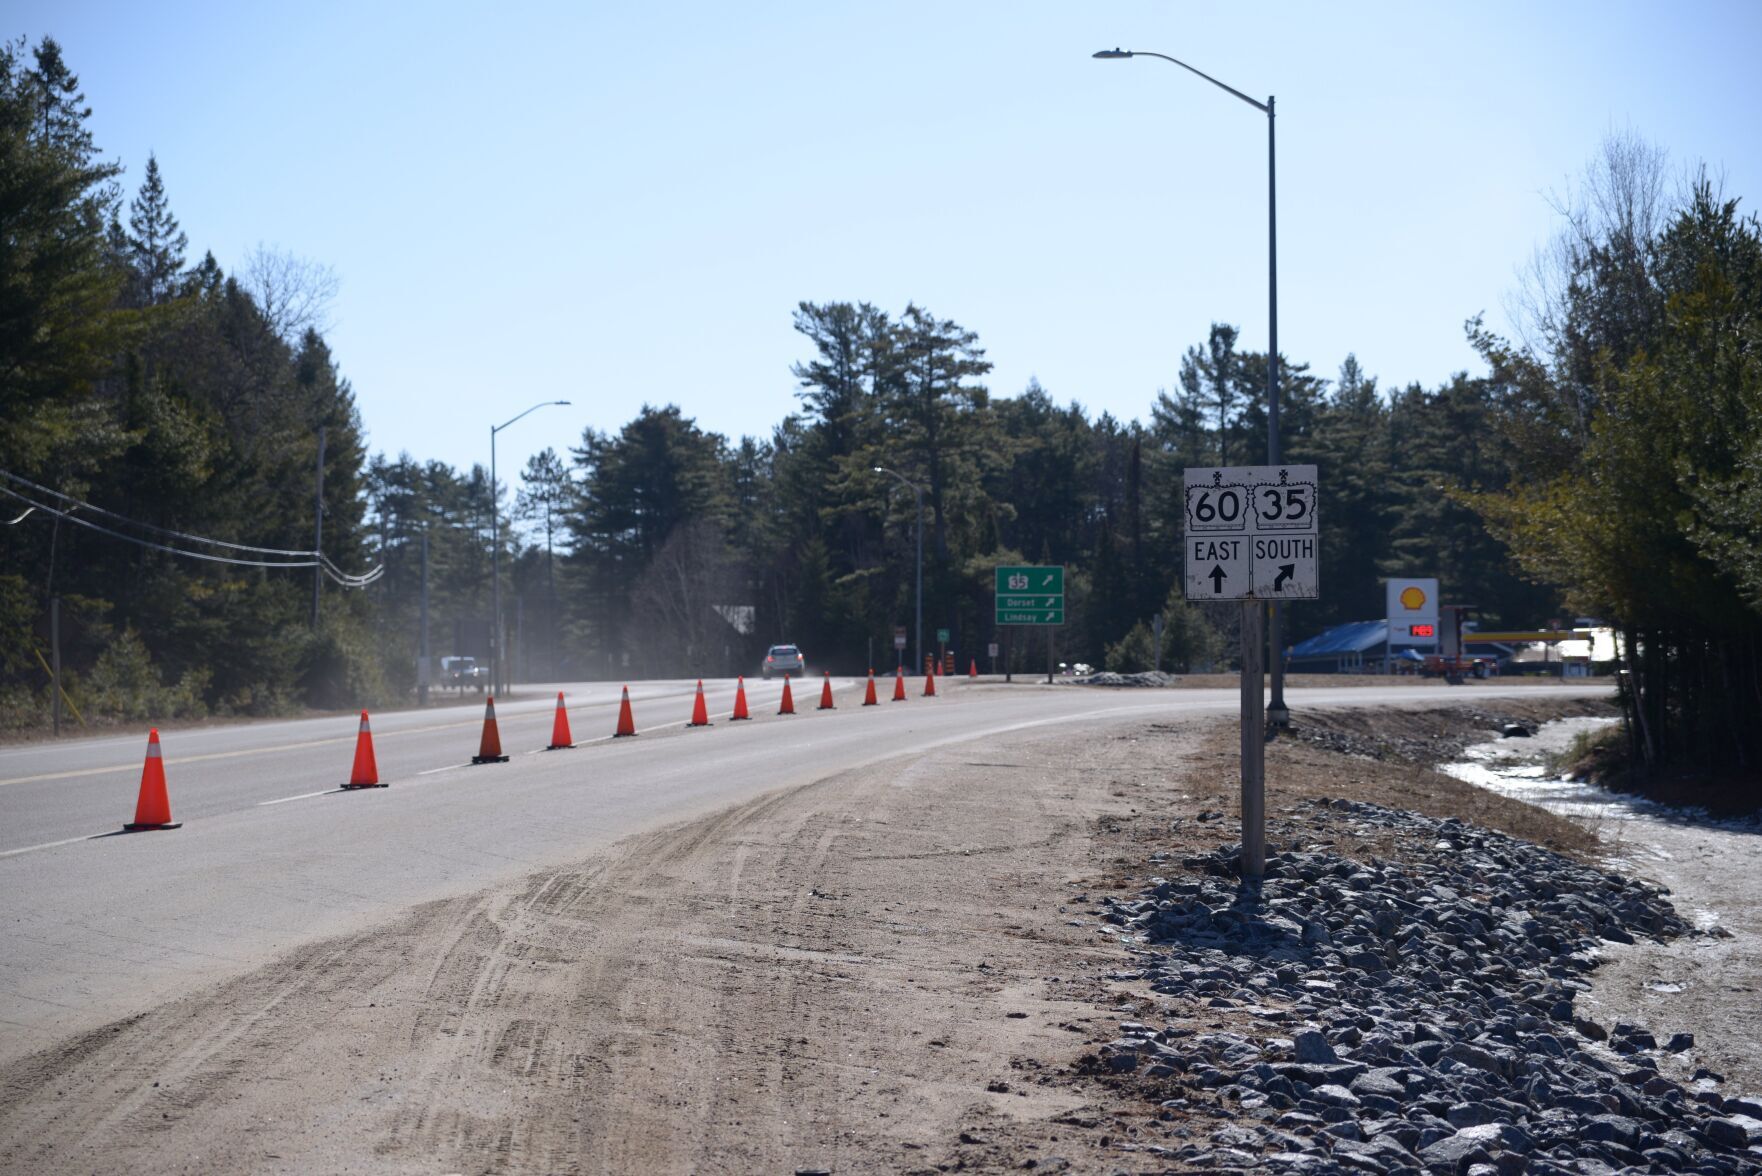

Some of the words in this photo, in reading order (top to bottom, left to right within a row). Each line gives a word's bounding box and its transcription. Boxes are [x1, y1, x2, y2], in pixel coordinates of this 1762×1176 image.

[1195, 491, 1240, 522] 60
[1262, 489, 1307, 521] 35
[1195, 541, 1240, 561] EAST
[1255, 539, 1313, 559] SOUTH
[1010, 577, 1027, 589] 35
[1007, 598, 1035, 607] Dorset
[1004, 613, 1037, 623] Lindsay
